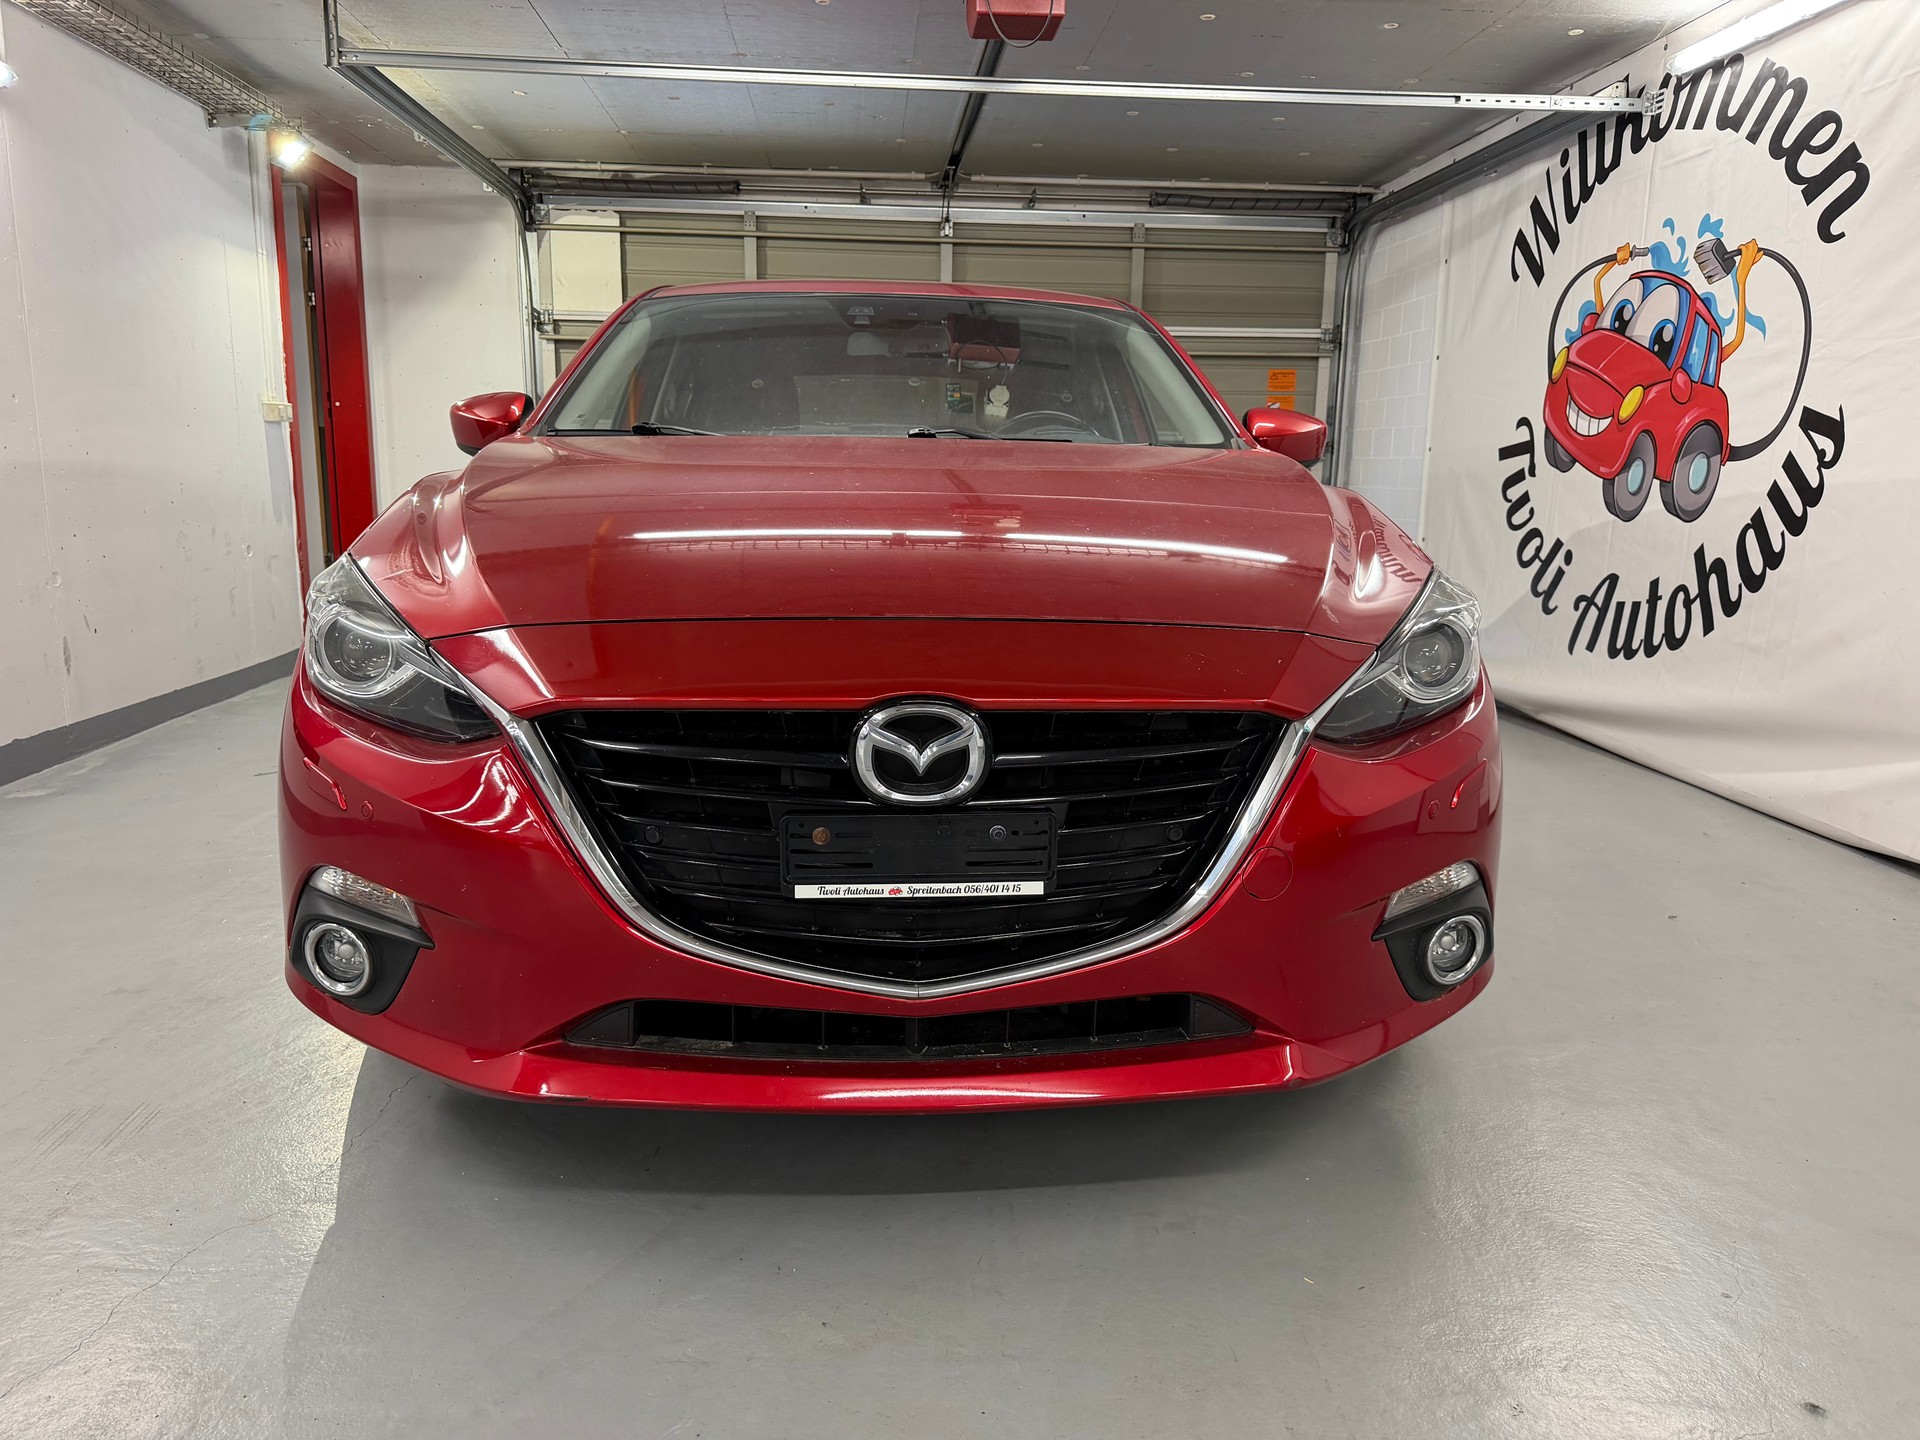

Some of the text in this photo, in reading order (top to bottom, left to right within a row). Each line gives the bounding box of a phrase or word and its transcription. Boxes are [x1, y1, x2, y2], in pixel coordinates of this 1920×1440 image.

[1510, 52, 1871, 288] Willkommen
[1498, 403, 1845, 661] Tivoli Autohaus
[817, 883, 1022, 897] Tivoli Autohaus Spreitenbach 056/401 14 15
